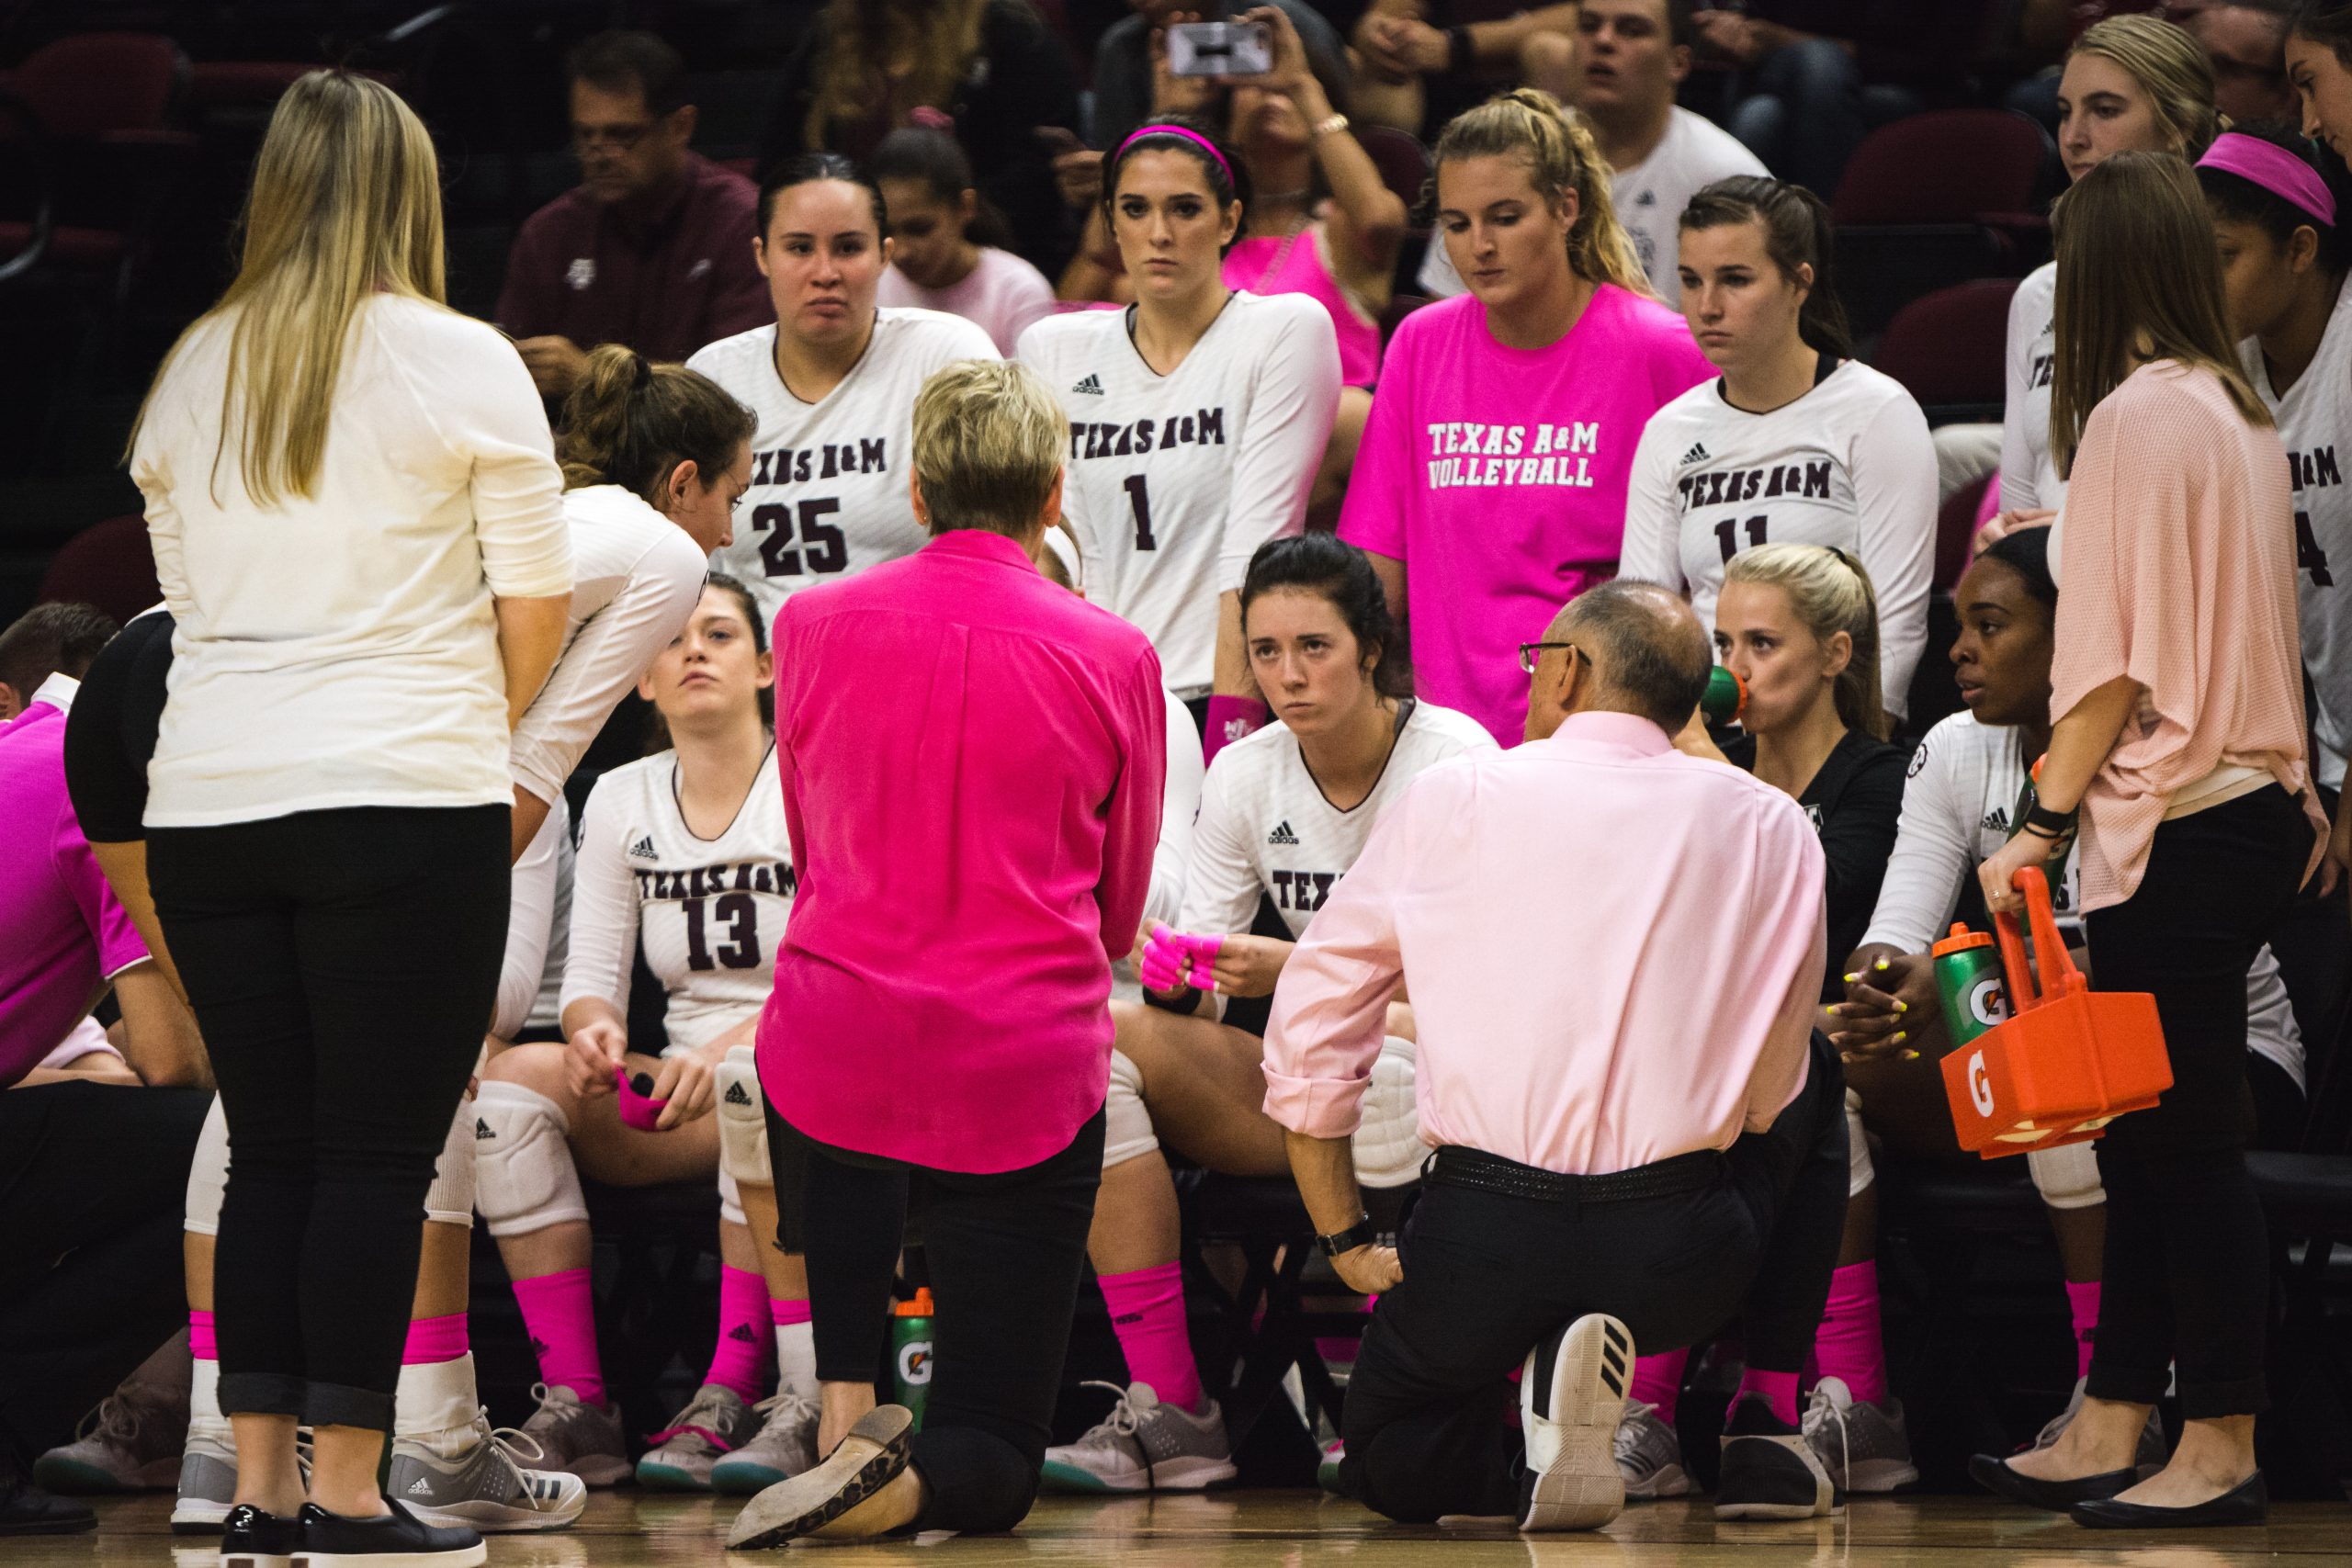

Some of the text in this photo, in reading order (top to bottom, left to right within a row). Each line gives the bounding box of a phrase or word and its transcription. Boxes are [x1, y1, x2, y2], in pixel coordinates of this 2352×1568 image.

[1072, 385, 1105, 396] adidas
[1070, 407, 1225, 459] TEXAS A&M
[1428, 422, 1600, 456] TEXAS A&M
[820, 436, 887, 479] A&M
[1428, 457, 1594, 490] VOLLEYBALL
[1678, 461, 1832, 513] TEXAS A&M
[1124, 473, 1157, 551] 1
[752, 497, 850, 577] 25
[1268, 835, 1299, 844] adidas
[1981, 820, 2010, 832] adida
[1272, 869, 1345, 912] TEX
[682, 893, 762, 971] 13
[1970, 977, 2008, 1026] G
[1968, 1049, 1995, 1118] G
[899, 1340, 933, 1385] G
